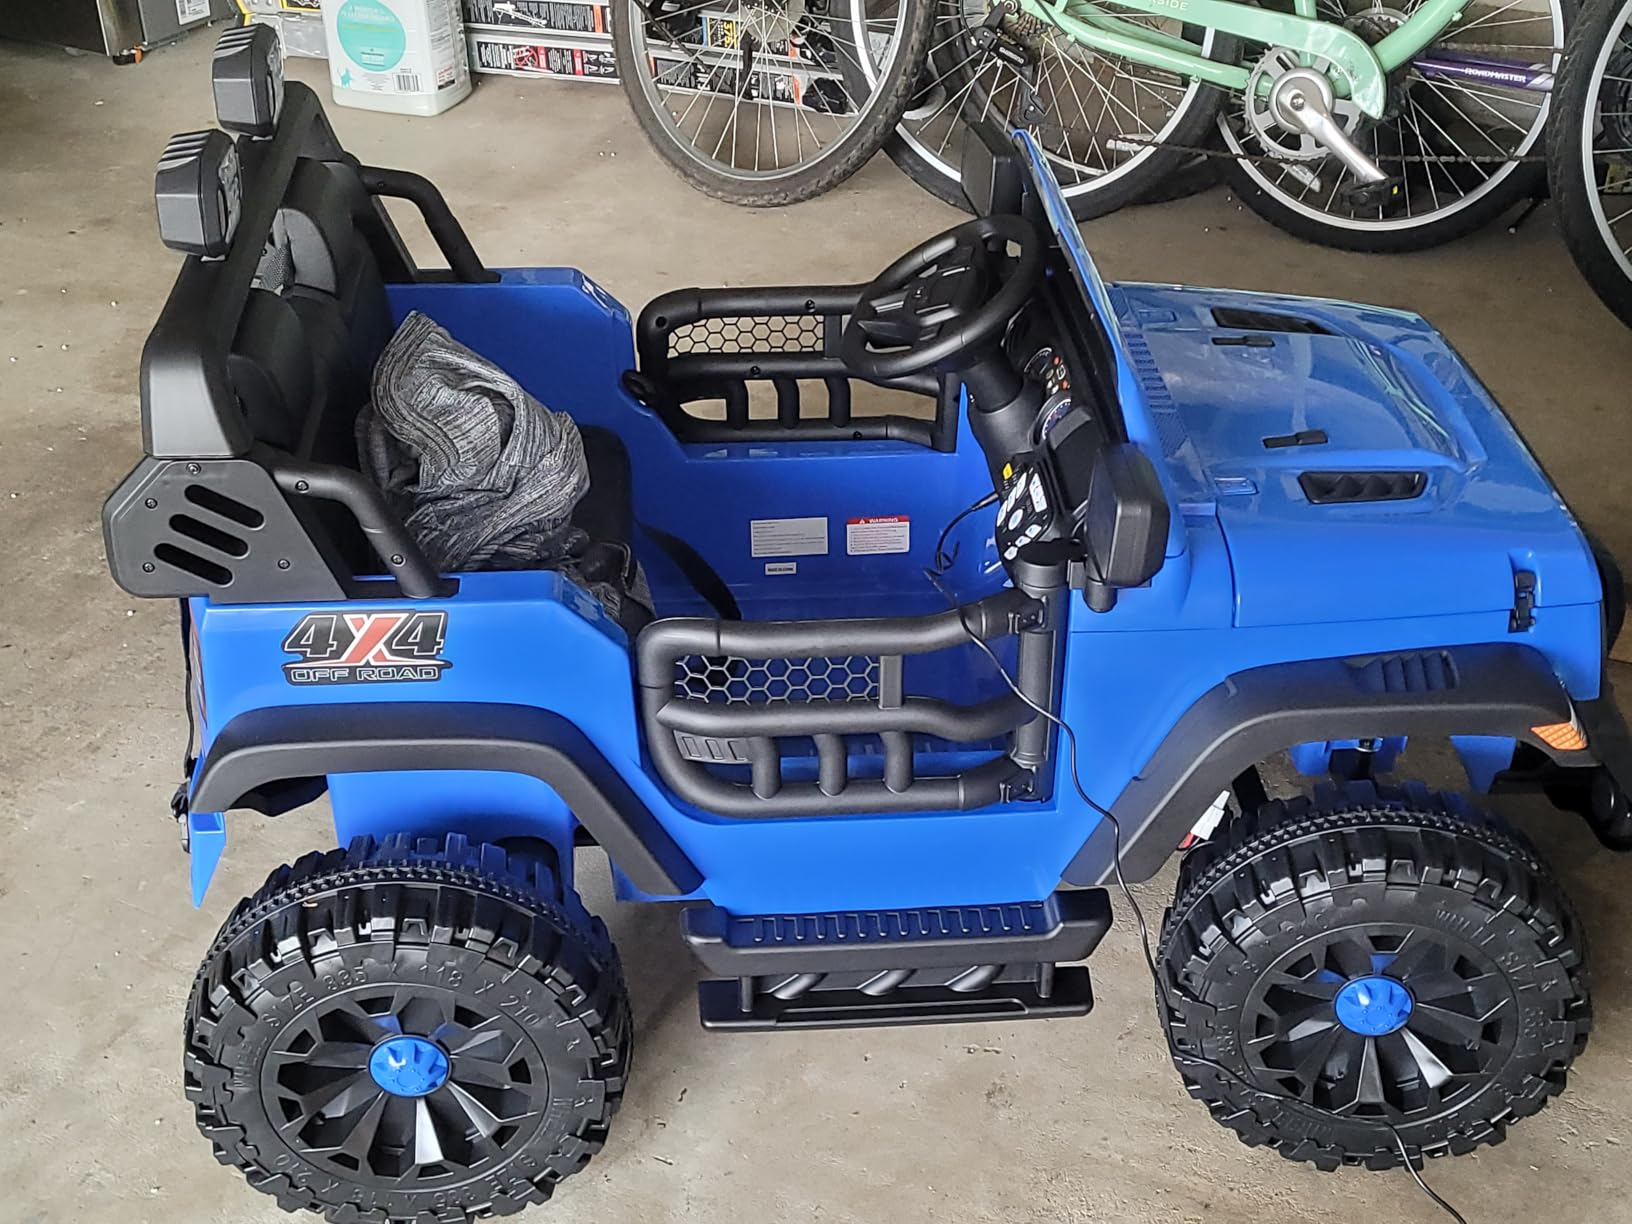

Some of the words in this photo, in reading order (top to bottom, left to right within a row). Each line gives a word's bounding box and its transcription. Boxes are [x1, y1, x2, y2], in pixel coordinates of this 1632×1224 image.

[284, 611, 446, 668] 4X4
[290, 667, 350, 682] OFF
[356, 666, 439, 681] ROAD
